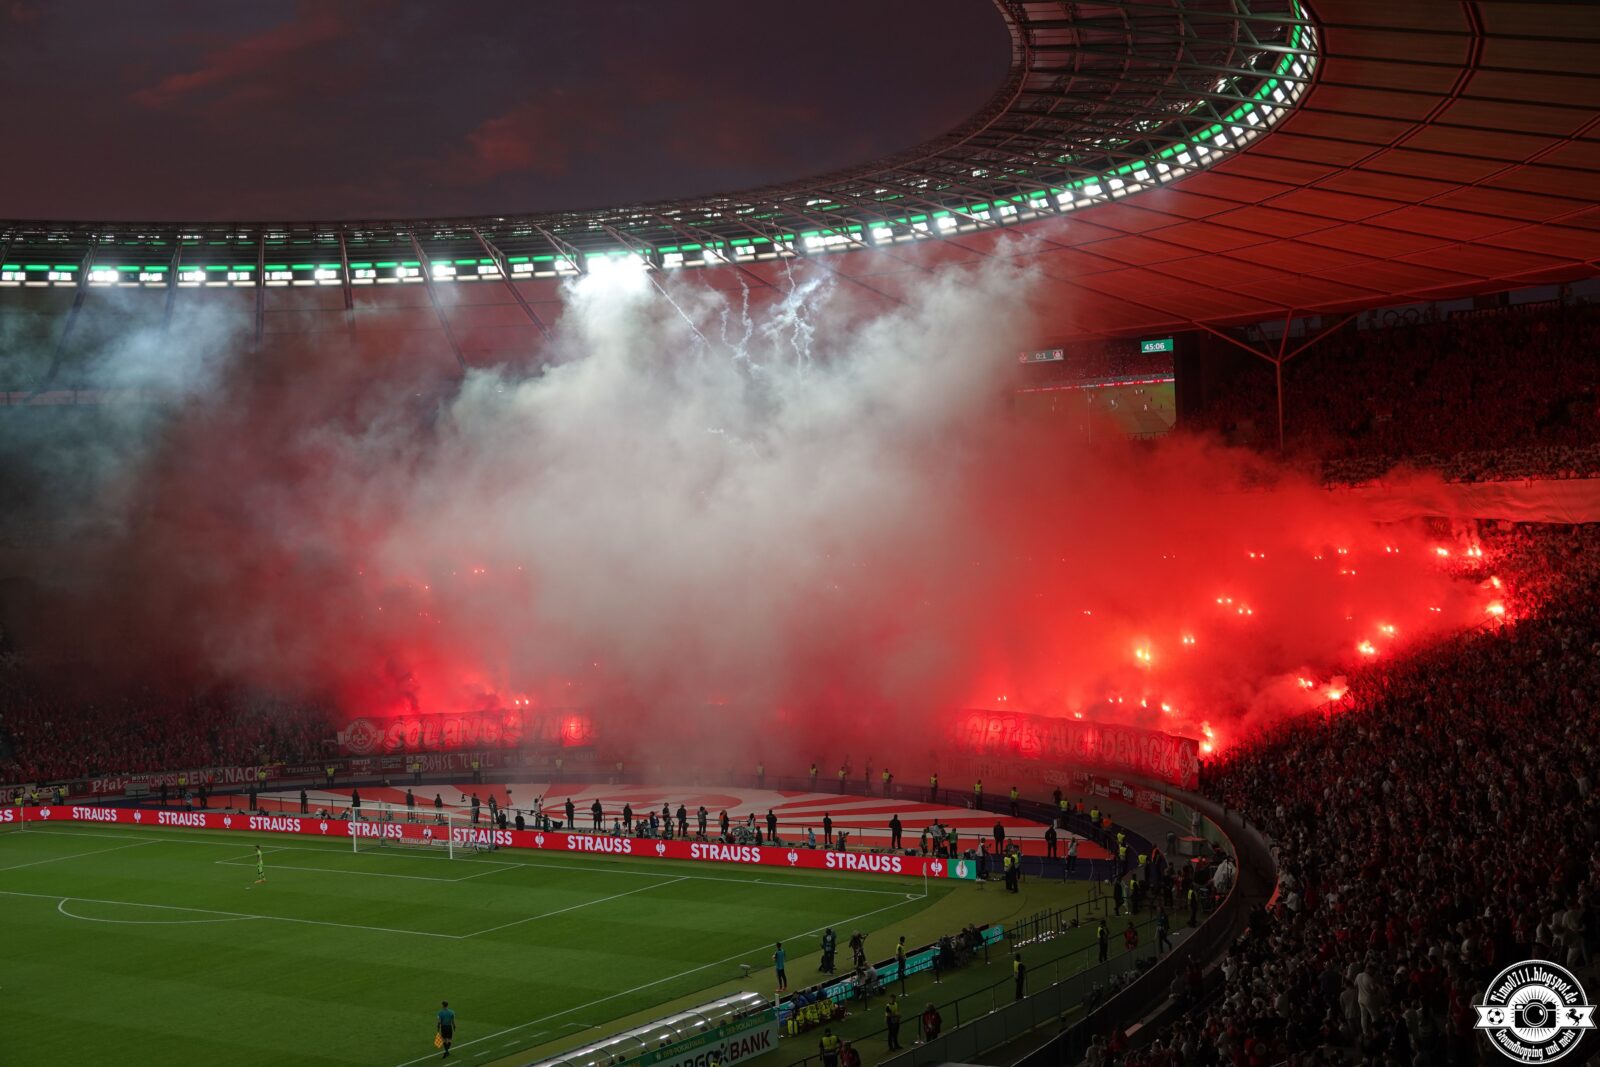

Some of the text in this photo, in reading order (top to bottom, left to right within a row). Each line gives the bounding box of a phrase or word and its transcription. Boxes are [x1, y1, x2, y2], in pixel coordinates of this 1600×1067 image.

[1144, 342, 1165, 350] 45:06
[72, 806, 117, 822] STRAUSS
[158, 811, 206, 827] STRAUSS
[249, 815, 301, 832] STRAUSS
[348, 821, 403, 838] STRAUSS
[453, 828, 513, 846] STRAUSS
[568, 834, 632, 854] STRAUSS
[691, 842, 761, 864] STRAUSS
[826, 851, 902, 873] STRAUSS
[730, 1029, 771, 1061] BANK
